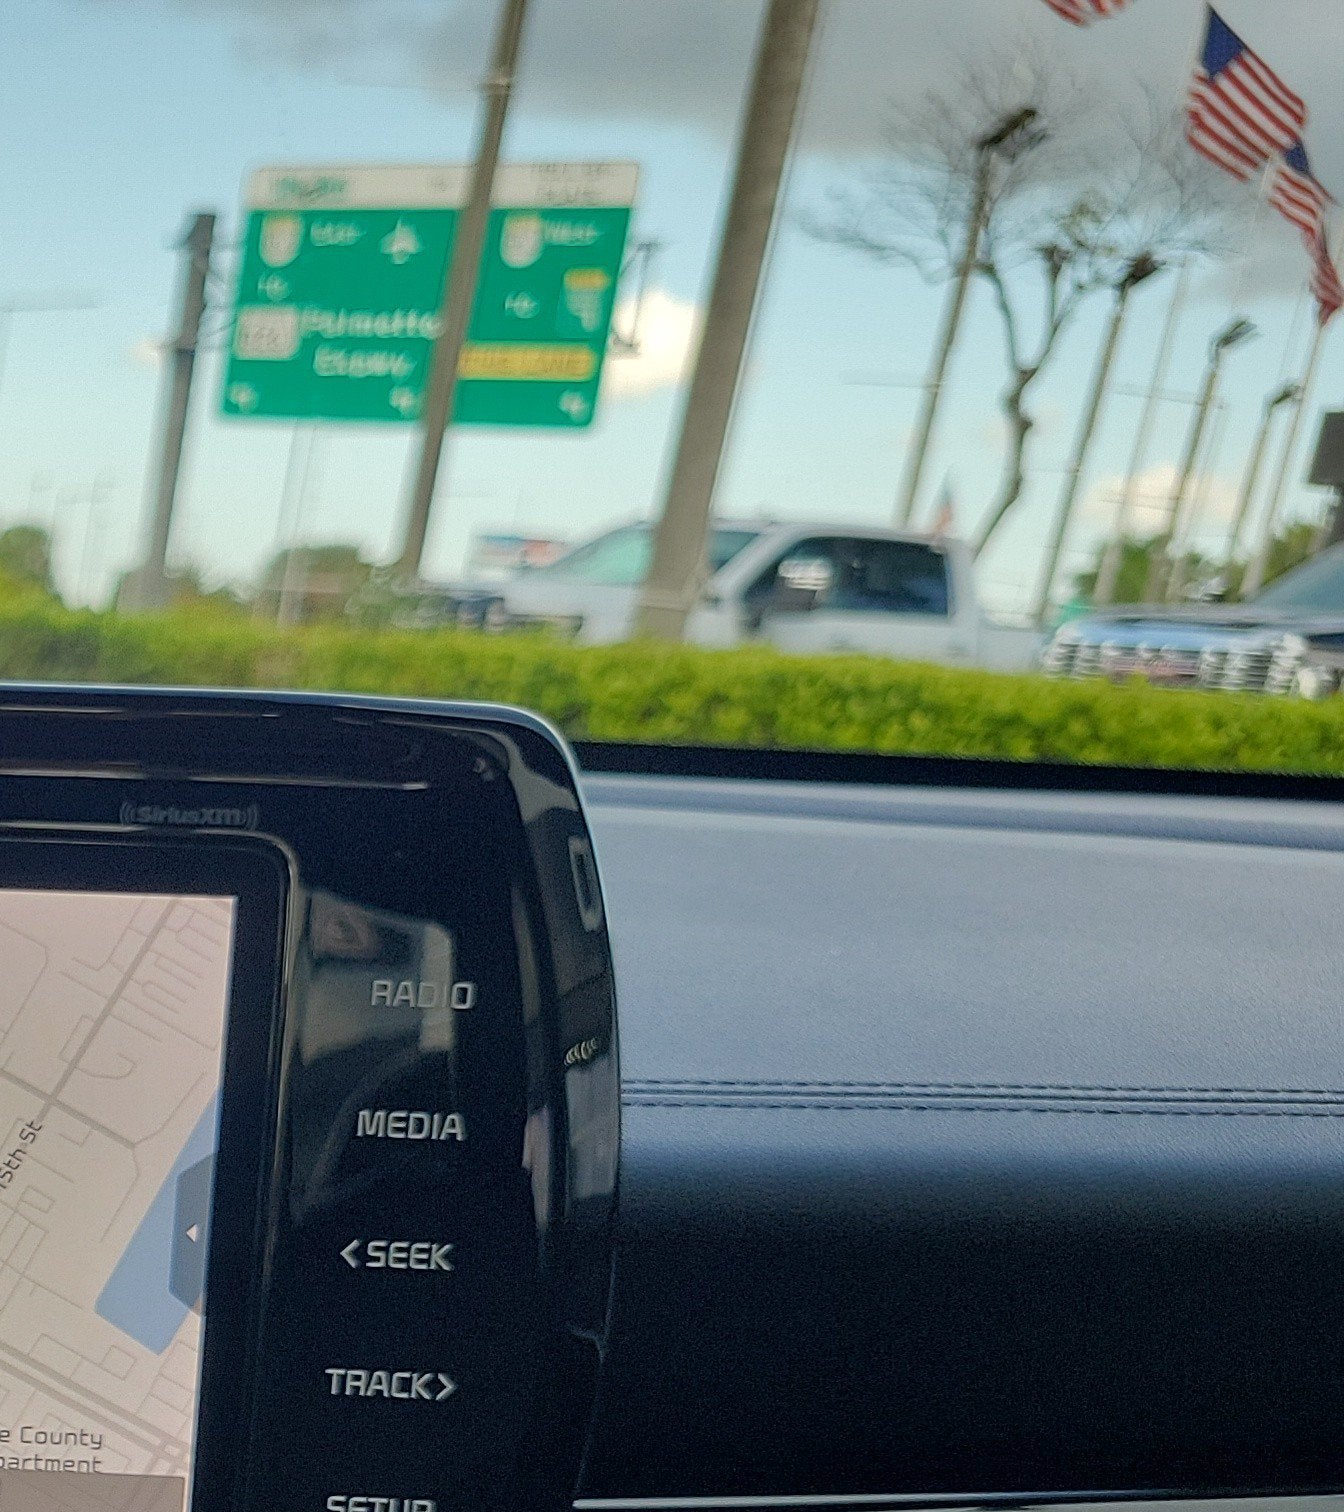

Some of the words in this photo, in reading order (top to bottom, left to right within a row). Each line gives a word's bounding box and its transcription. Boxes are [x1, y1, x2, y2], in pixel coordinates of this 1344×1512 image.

[370, 979, 475, 1010] RADIO
[18, 1119, 43, 1151] St
[356, 1108, 466, 1141] MEDIA
[20, 1424, 104, 1451] County
